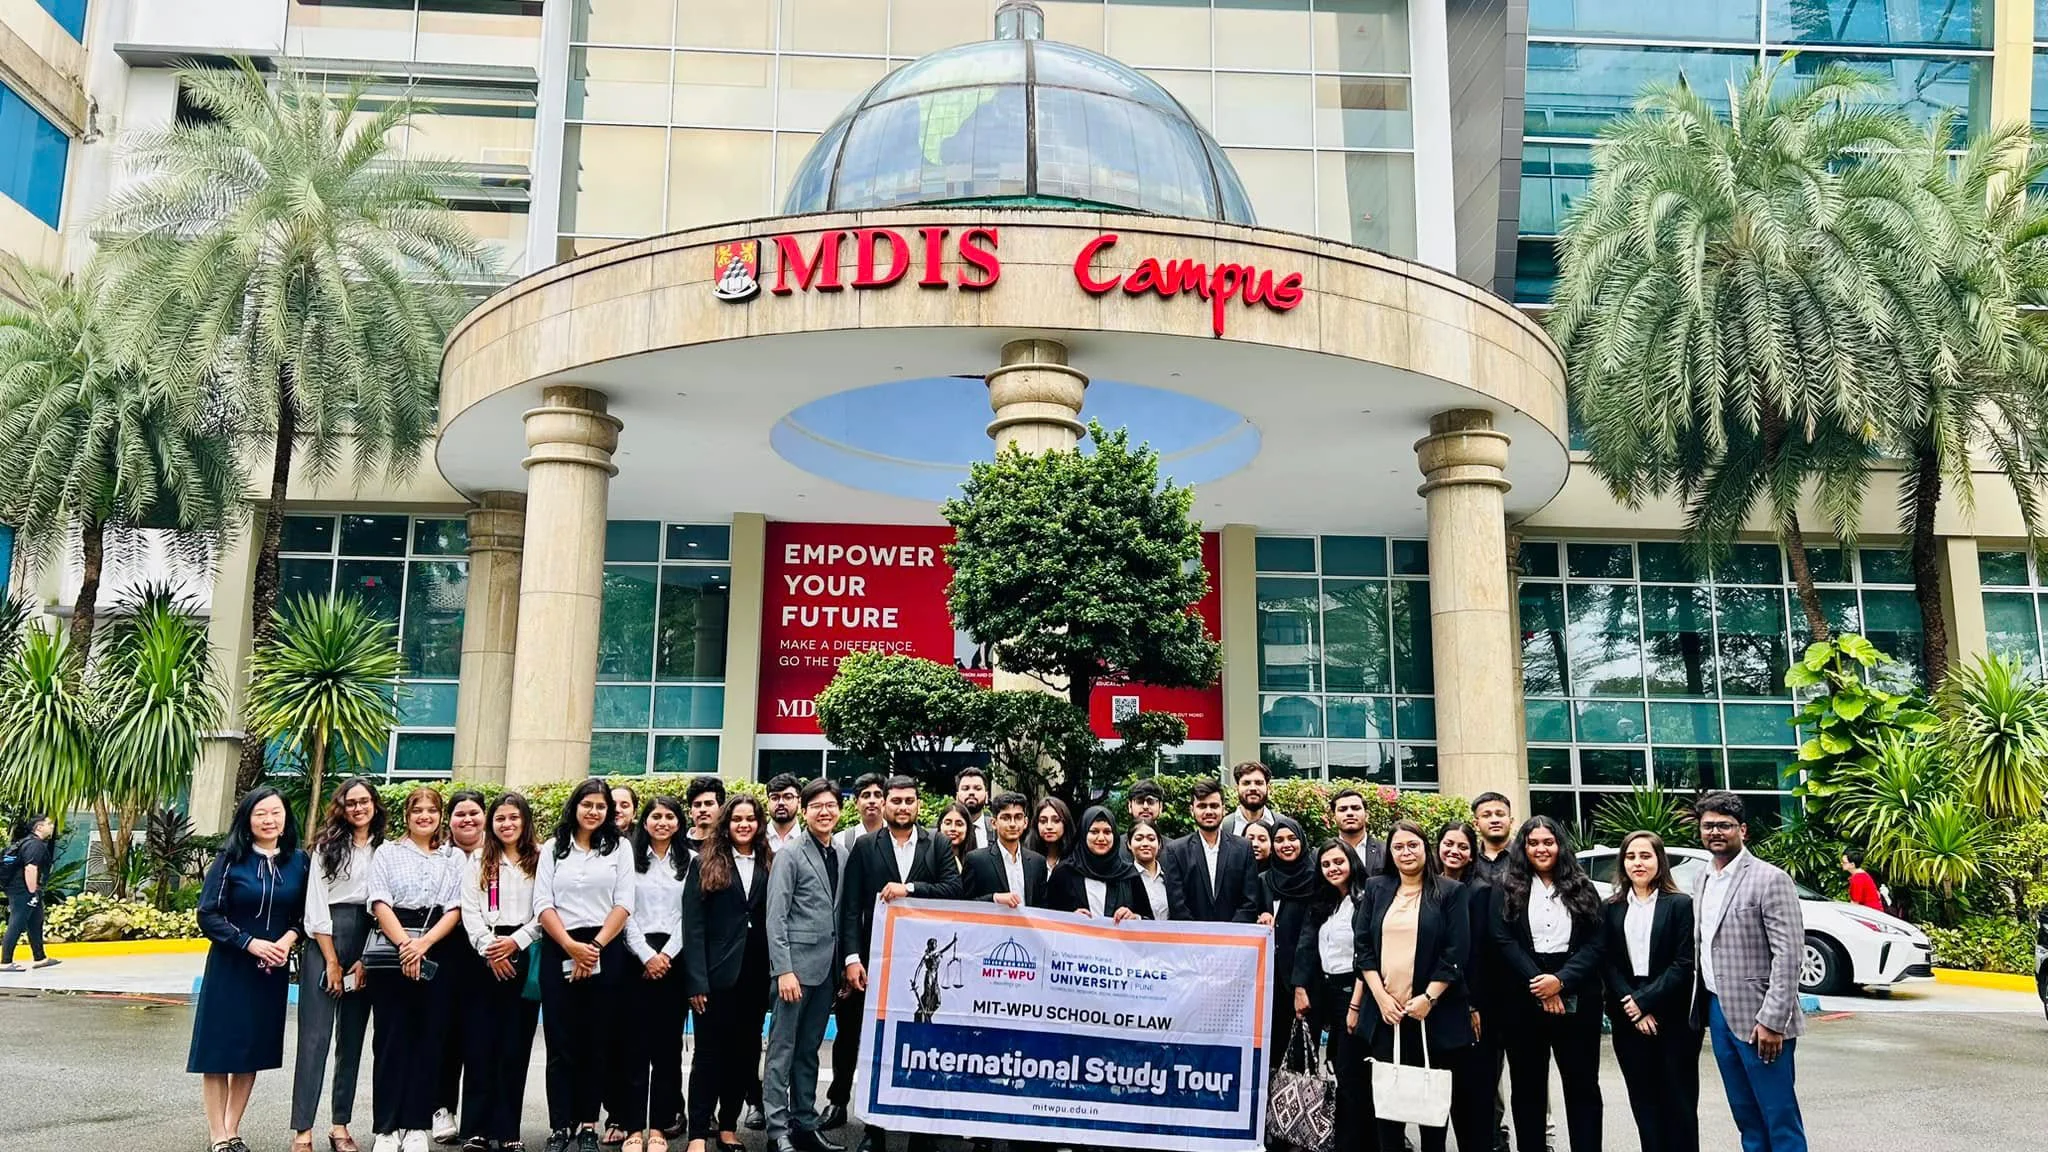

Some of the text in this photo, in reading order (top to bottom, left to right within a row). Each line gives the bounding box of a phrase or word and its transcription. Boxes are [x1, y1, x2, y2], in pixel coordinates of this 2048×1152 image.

[771, 226, 1305, 338] MDIS Campus
[784, 543, 935, 567] EMPOWER
[783, 574, 866, 597] YOUR
[781, 606, 899, 629] FUTURE
[779, 639, 817, 651] MAKE
[820, 640, 830, 651] A
[778, 656, 800, 667] GO
[804, 656, 829, 667] THE
[982, 967, 1036, 981] MIT-WPU
[1051, 959, 1168, 981] MIT WORLD PEACE
[1050, 973, 1153, 992] UNIVERSITY PUNE
[972, 999, 1172, 1031] MIT-WPU SCHOOL OF LAW
[900, 1042, 1234, 1096] International Study Tour
[1032, 1102, 1099, 1117] mitwpu.edu.in
